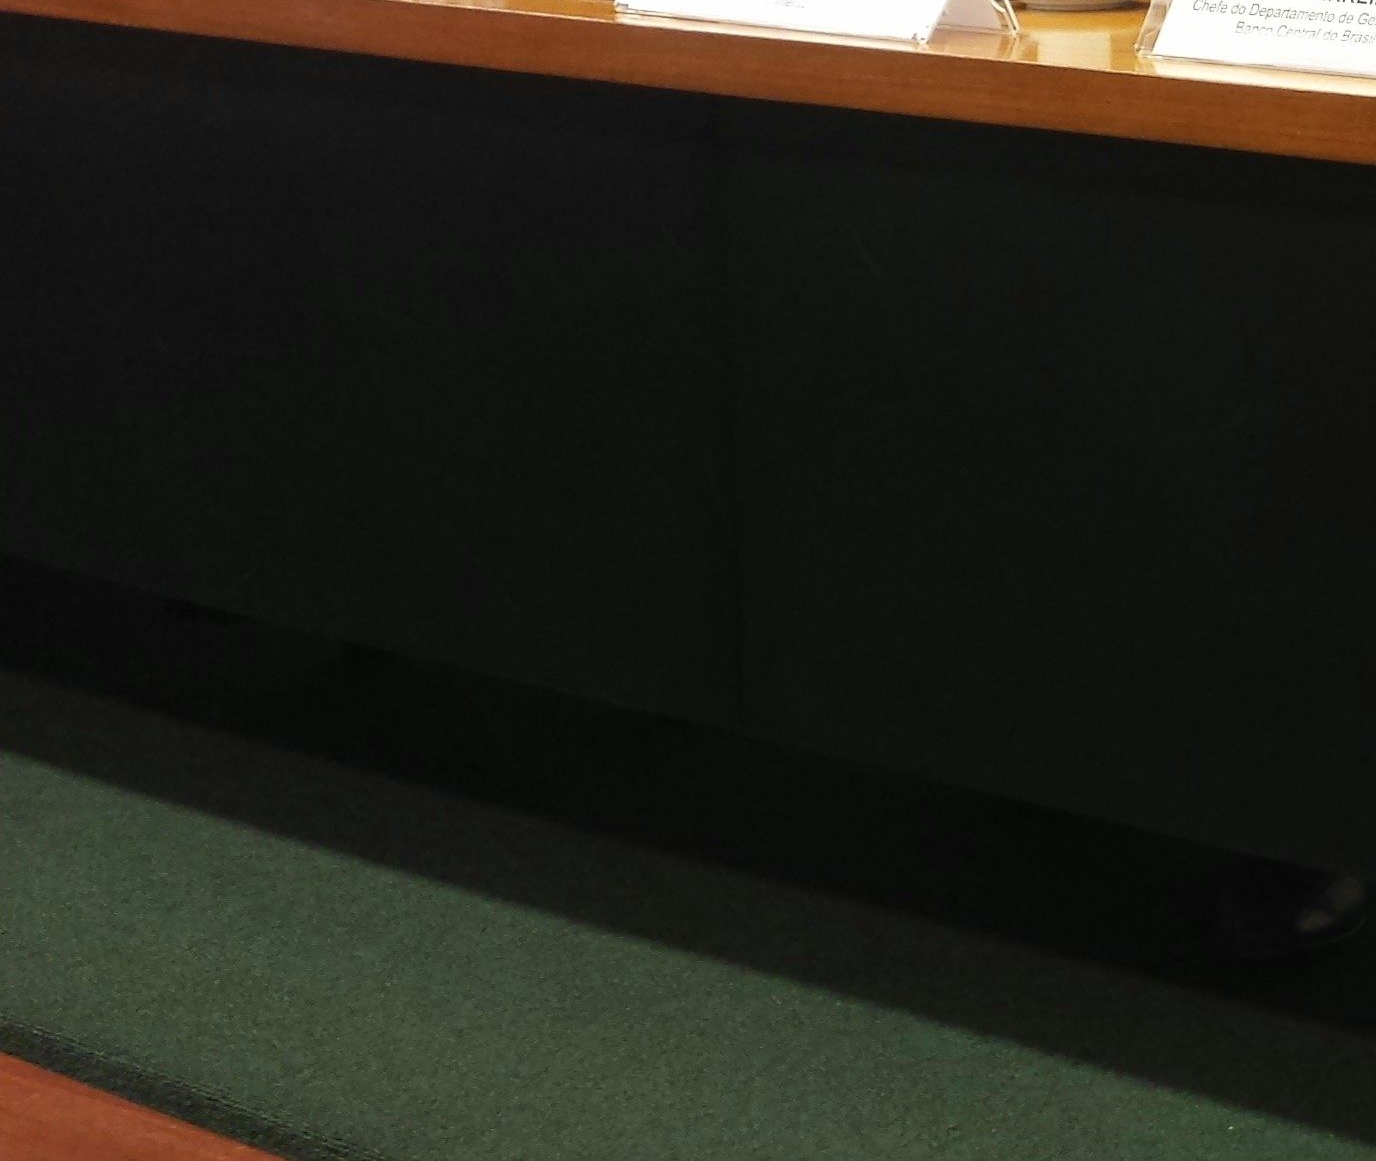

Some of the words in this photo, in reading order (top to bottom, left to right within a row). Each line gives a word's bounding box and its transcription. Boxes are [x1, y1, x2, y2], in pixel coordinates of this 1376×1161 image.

[1230, 3, 1246, 14] do
[1248, 3, 1335, 22] Departamento
[1338, 11, 1353, 23] de
[1234, 20, 1273, 35] Banco
[1276, 24, 1321, 38] Central
[1322, 29, 1338, 40] do
[1340, 29, 1376, 43] Brasil
